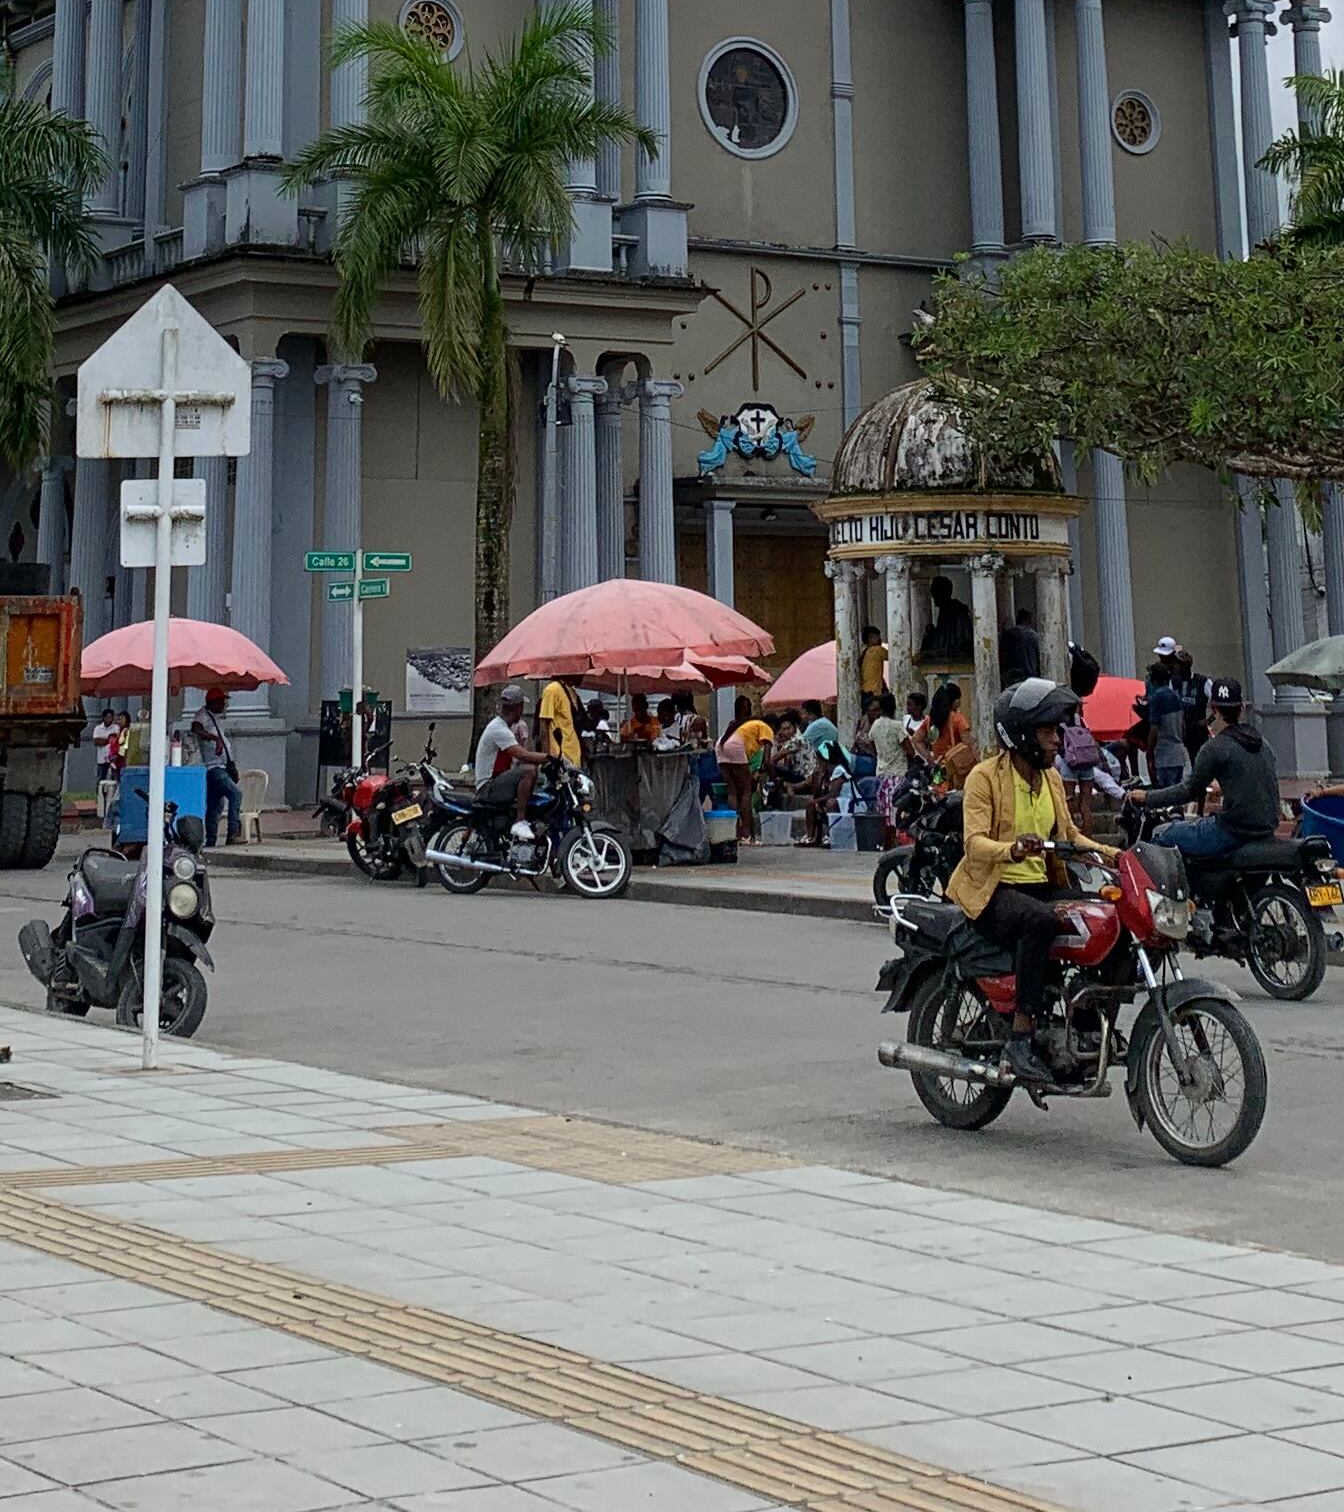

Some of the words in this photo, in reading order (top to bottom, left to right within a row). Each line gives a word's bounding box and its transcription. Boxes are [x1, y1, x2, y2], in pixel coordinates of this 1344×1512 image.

[914, 511, 978, 540] CESAR
[985, 512, 1039, 540] CONTO
[311, 556, 336, 567] Calle
[337, 556, 350, 567] 26
